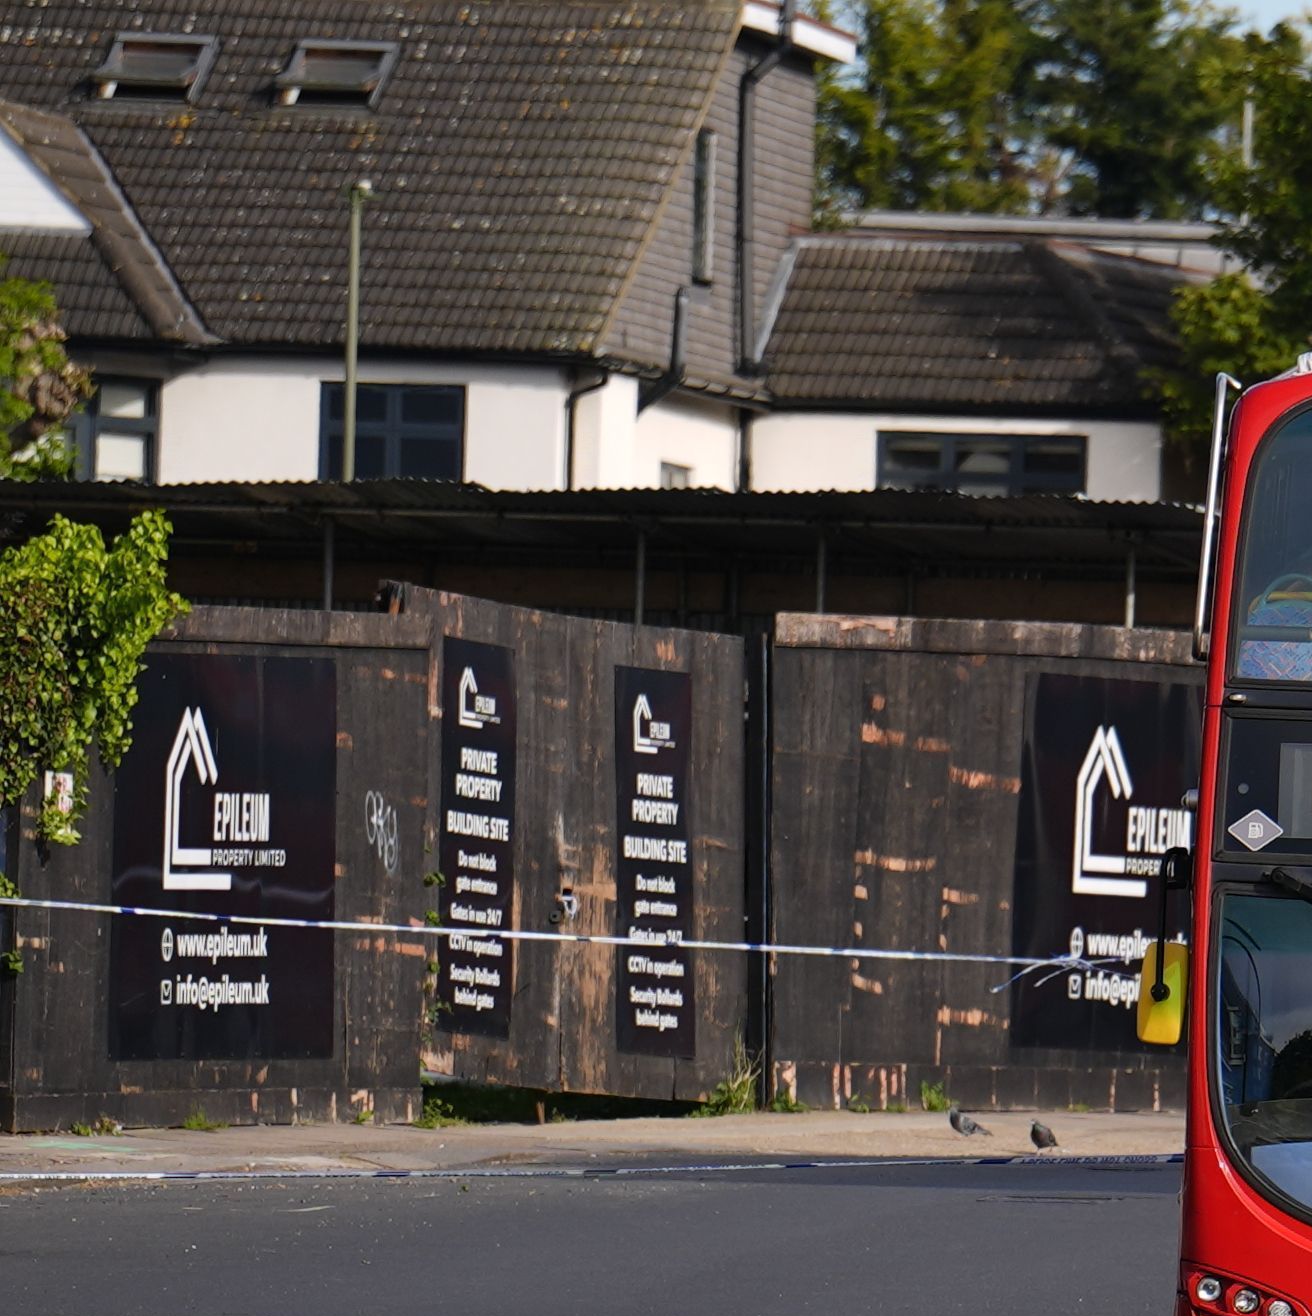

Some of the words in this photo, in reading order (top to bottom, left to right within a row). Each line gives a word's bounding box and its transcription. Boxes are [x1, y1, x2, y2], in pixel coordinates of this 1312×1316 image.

[461, 747, 498, 775] PRIVATE
[456, 773, 502, 801] PROPERTY
[637, 773, 673, 799] PRIVATE
[214, 793, 270, 841] EPILEUM
[632, 799, 679, 825] PROPERTY
[447, 810, 489, 838] BUILDING
[490, 817, 509, 840] SITE
[212, 849, 253, 867] PROPERTY
[255, 849, 286, 867] LIMITED
[458, 850, 468, 868] Do
[480, 852, 497, 872] block
[623, 835, 667, 862] BUILDING
[668, 840, 687, 864] SITE
[635, 874, 646, 892] Do
[658, 875, 675, 894] block
[451, 902, 468, 922] Gates
[487, 908, 502, 926] 24/7
[634, 900, 649, 917] gate
[650, 901, 677, 917] entrance
[177, 927, 268, 965] www.epileum.uk
[449, 934, 466, 951] CCTV
[473, 939, 503, 958] operation
[450, 963, 474, 987] Security
[628, 955, 647, 973] CCTV
[654, 960, 684, 979] operation
[176, 974, 269, 1012] info@epileum.uk
[455, 986, 477, 1006] behind
[477, 994, 494, 1011] gates
[630, 986, 656, 1008] Security
[657, 987, 683, 1007] Bollards
[636, 1008, 659, 1028] behind
[659, 1014, 678, 1031] gates
